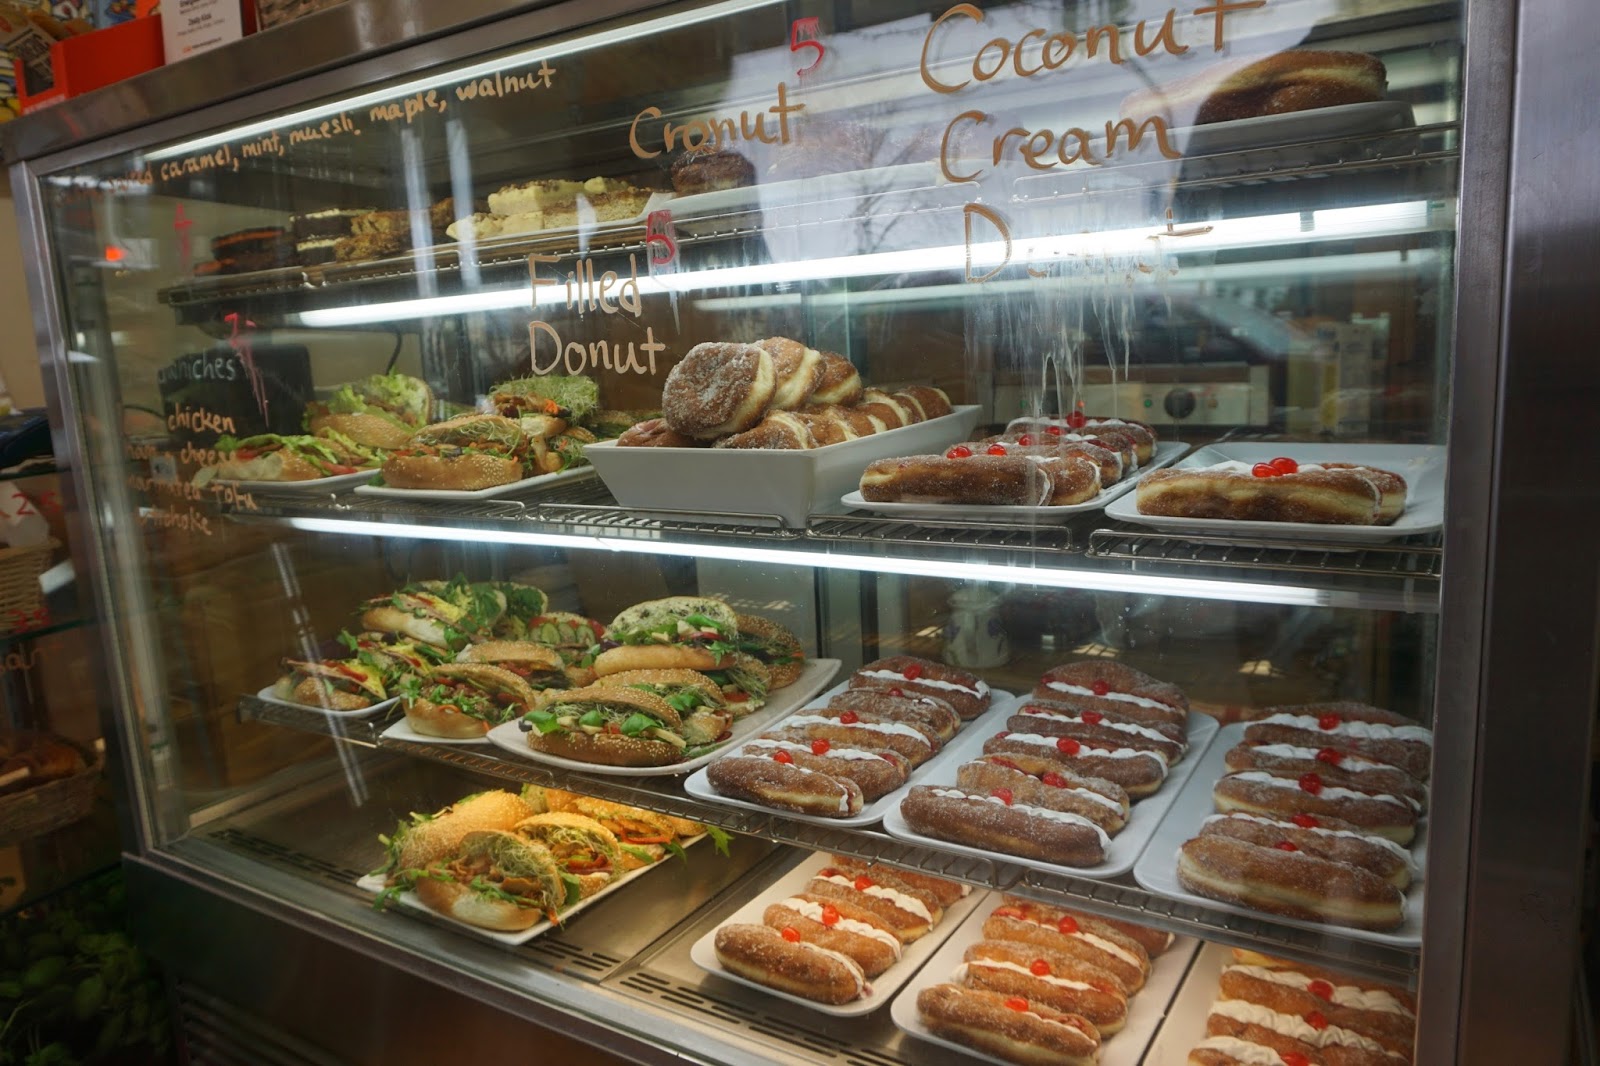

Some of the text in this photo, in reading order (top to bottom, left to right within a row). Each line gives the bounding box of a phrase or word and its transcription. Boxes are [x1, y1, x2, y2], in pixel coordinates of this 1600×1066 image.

[790, 16, 825, 76] 5
[920, 0, 1268, 94] Coconut
[161, 145, 239, 181] caramel,
[242, 130, 285, 157] mint,
[370, 90, 447, 123] maple,
[455, 58, 557, 102] walnut
[629, 82, 806, 159] Cronut
[940, 110, 1182, 184] Cream
[528, 252, 643, 318] Filled
[528, 320, 666, 376] Donut
[167, 402, 236, 434] chicken
